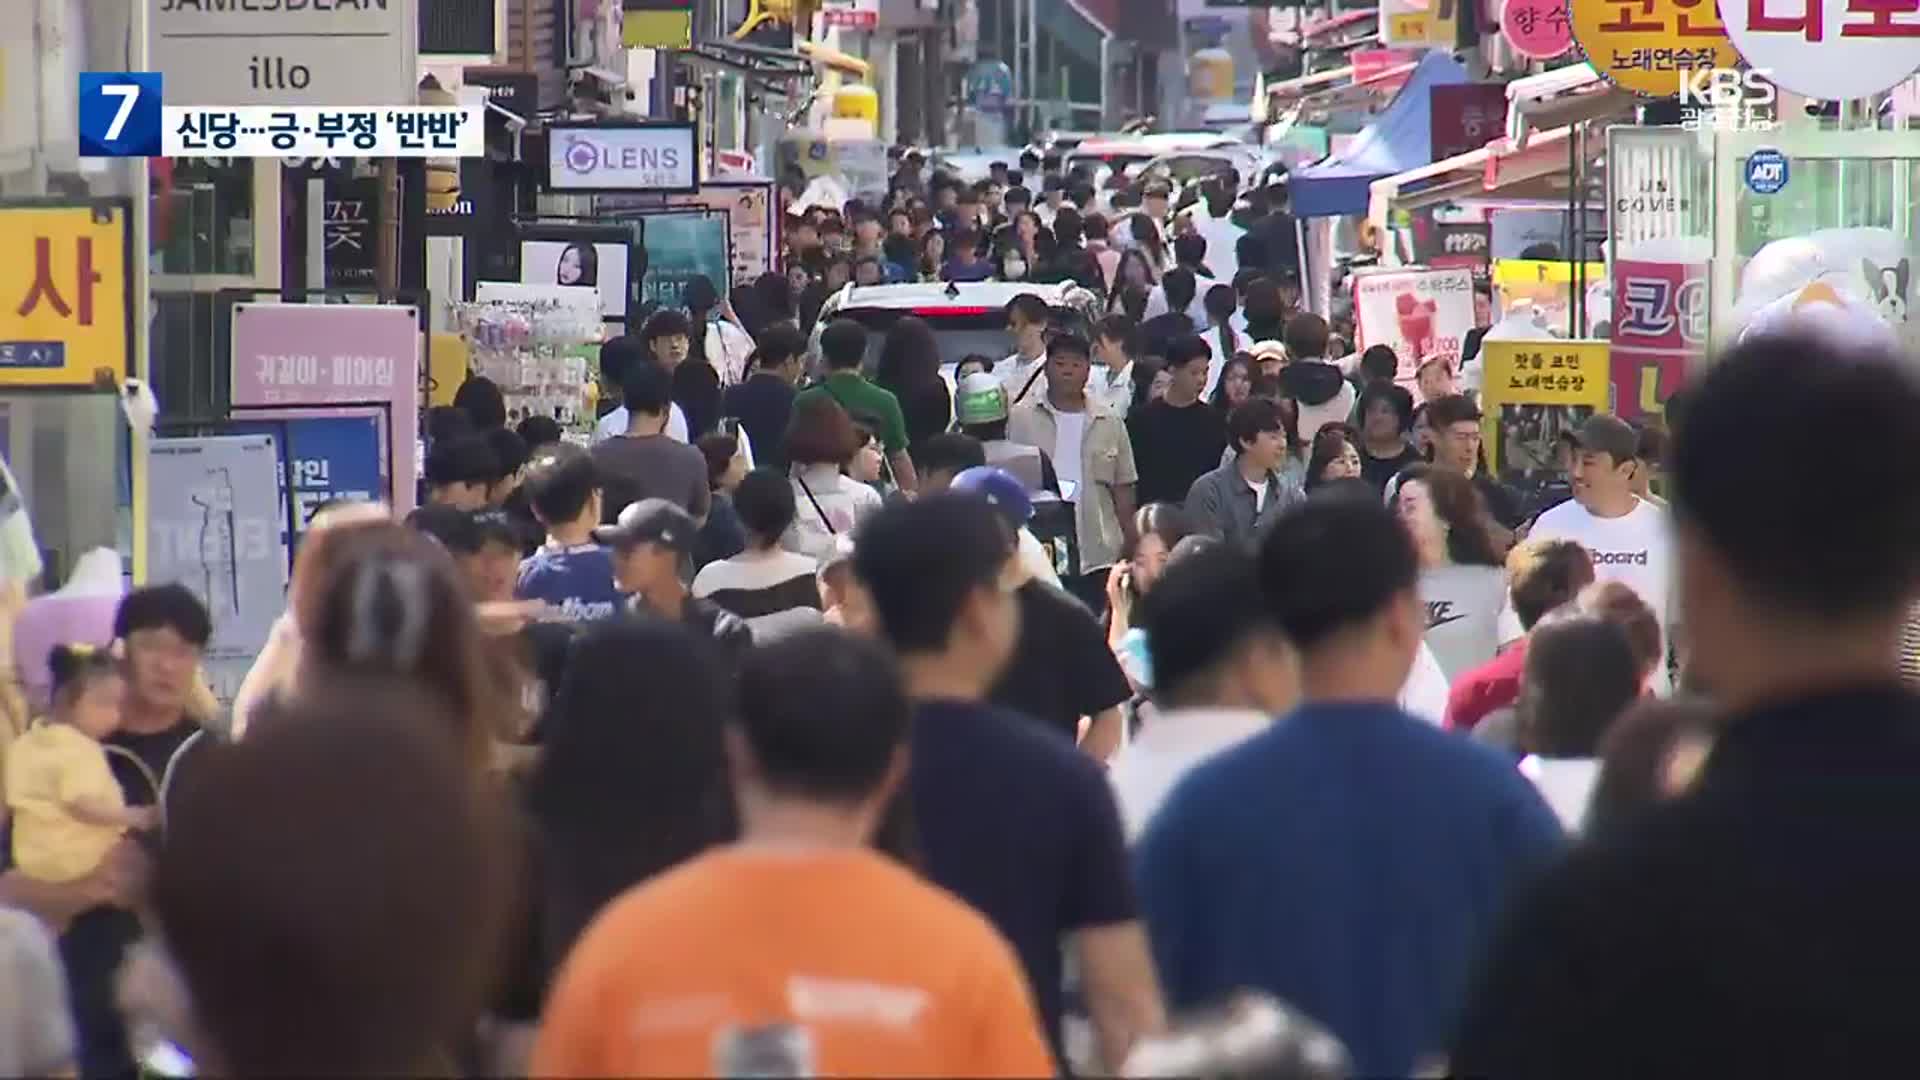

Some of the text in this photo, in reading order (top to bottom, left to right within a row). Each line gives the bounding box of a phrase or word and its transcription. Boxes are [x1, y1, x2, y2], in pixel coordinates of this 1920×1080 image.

[250, 56, 311, 89] illo
[1611, 48, 1718, 71] 노래연습장
[1751, 163, 1784, 181] ADT
[17, 236, 102, 326] 사
